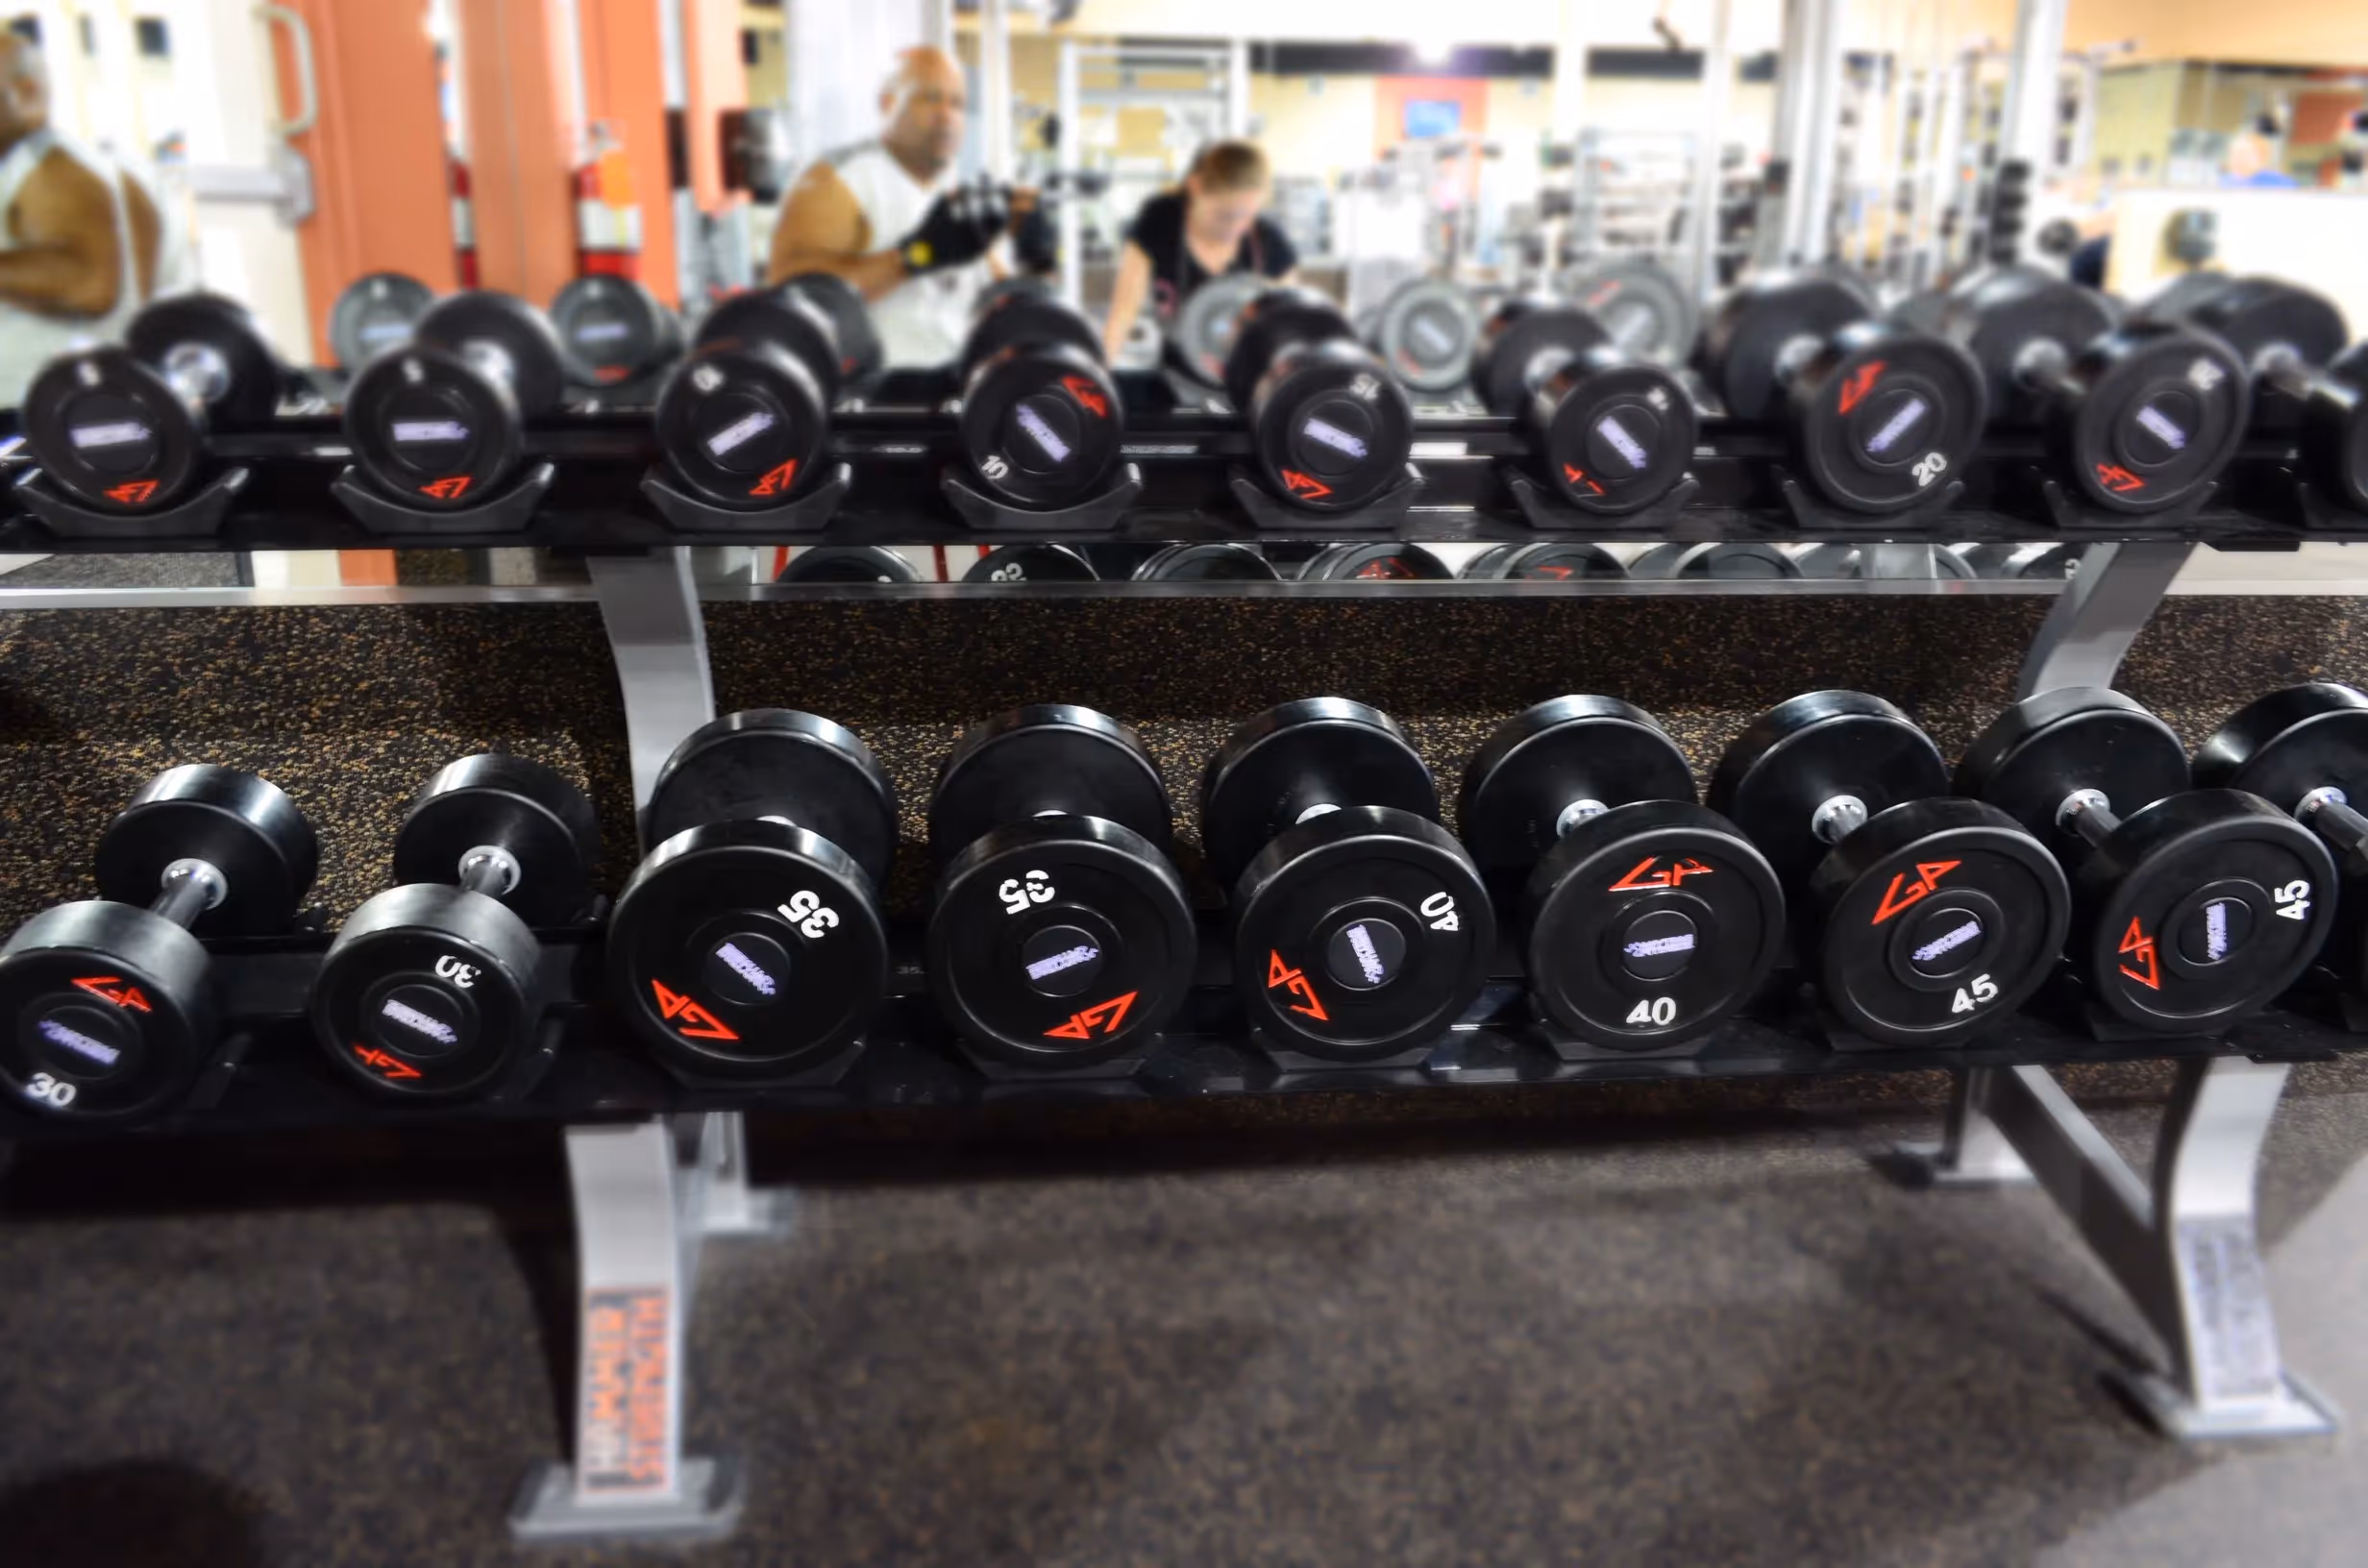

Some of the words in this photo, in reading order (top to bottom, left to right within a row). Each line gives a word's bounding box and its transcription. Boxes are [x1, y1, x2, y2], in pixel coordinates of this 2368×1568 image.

[980, 454, 1009, 480] 10
[1911, 452, 1948, 487] 20
[999, 870, 1056, 915] 35
[1419, 891, 1460, 932] 40
[2274, 879, 2311, 920] 45
[777, 890, 840, 939] 35
[434, 954, 482, 989] 30
[1625, 996, 1677, 1026] 40
[1951, 972, 1999, 1014] 45
[24, 1071, 77, 1108] 30
